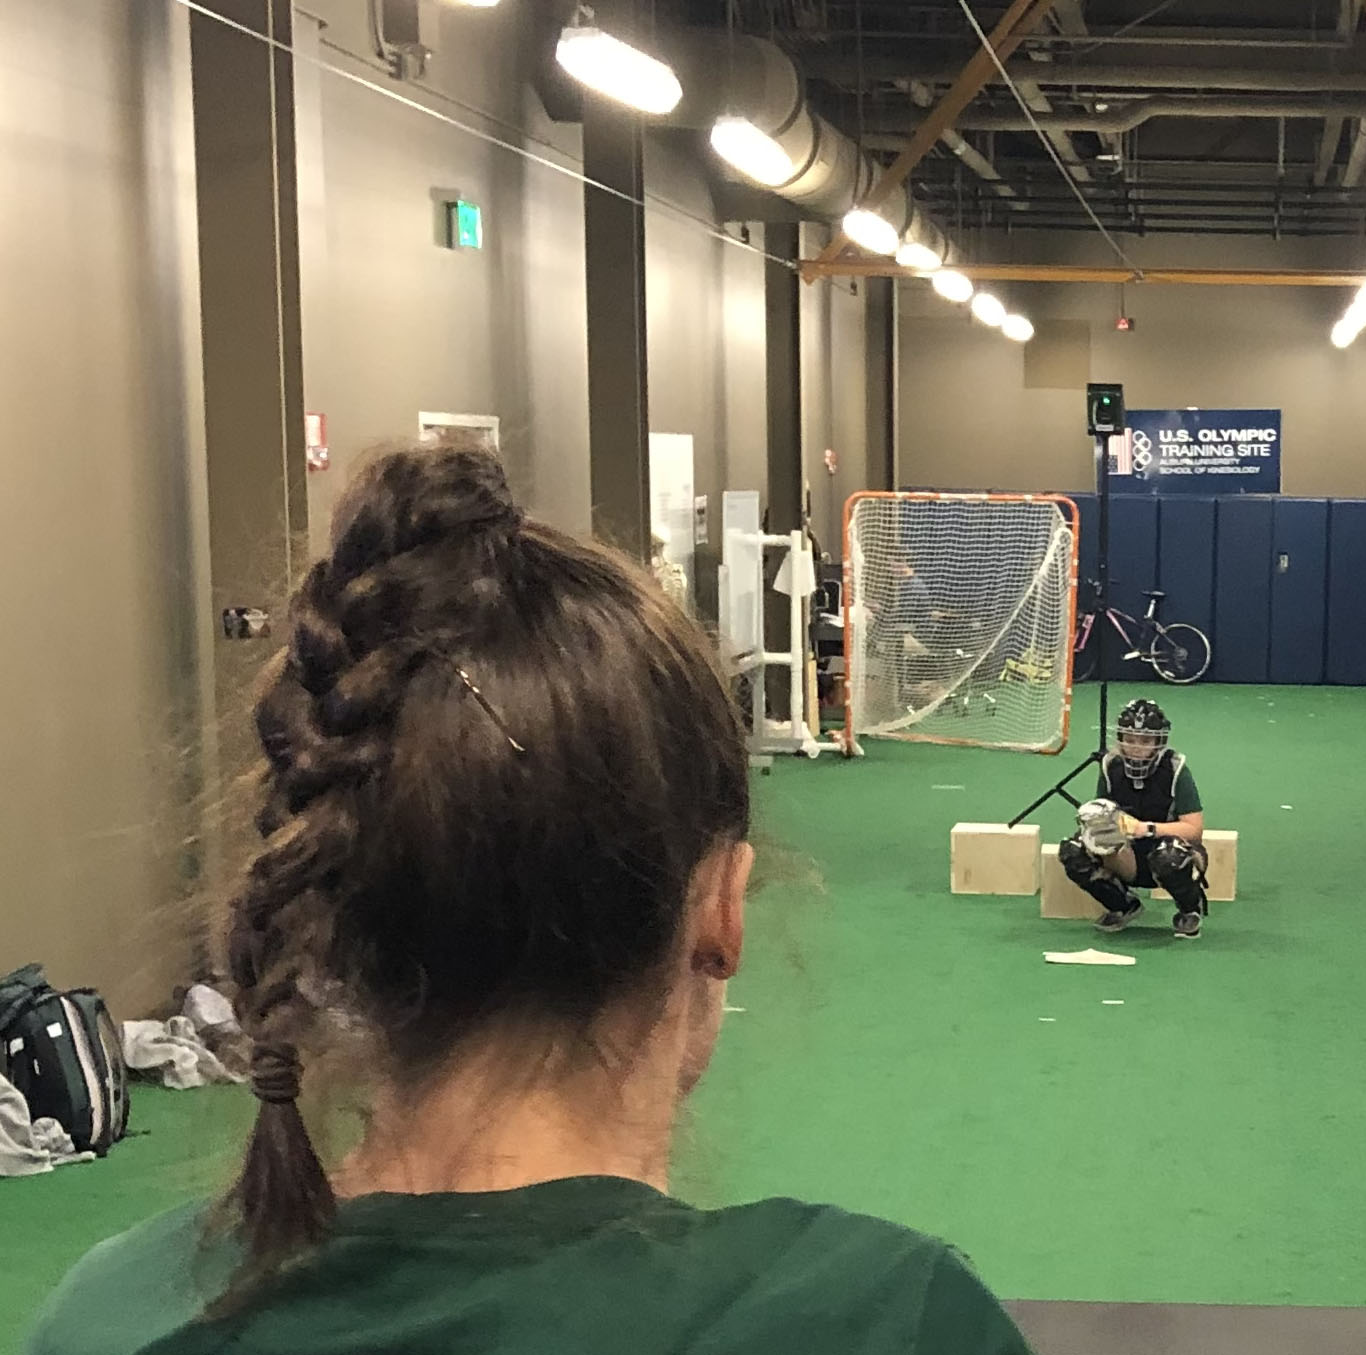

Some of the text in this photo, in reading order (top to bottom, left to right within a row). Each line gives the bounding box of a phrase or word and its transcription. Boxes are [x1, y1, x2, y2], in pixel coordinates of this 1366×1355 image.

[1159, 428, 1277, 442] U.S. OLYMPIC
[1159, 443, 1271, 457] TRAINING SITE
[1159, 466, 1193, 475] SCHOOL
[1194, 466, 1206, 475] OF
